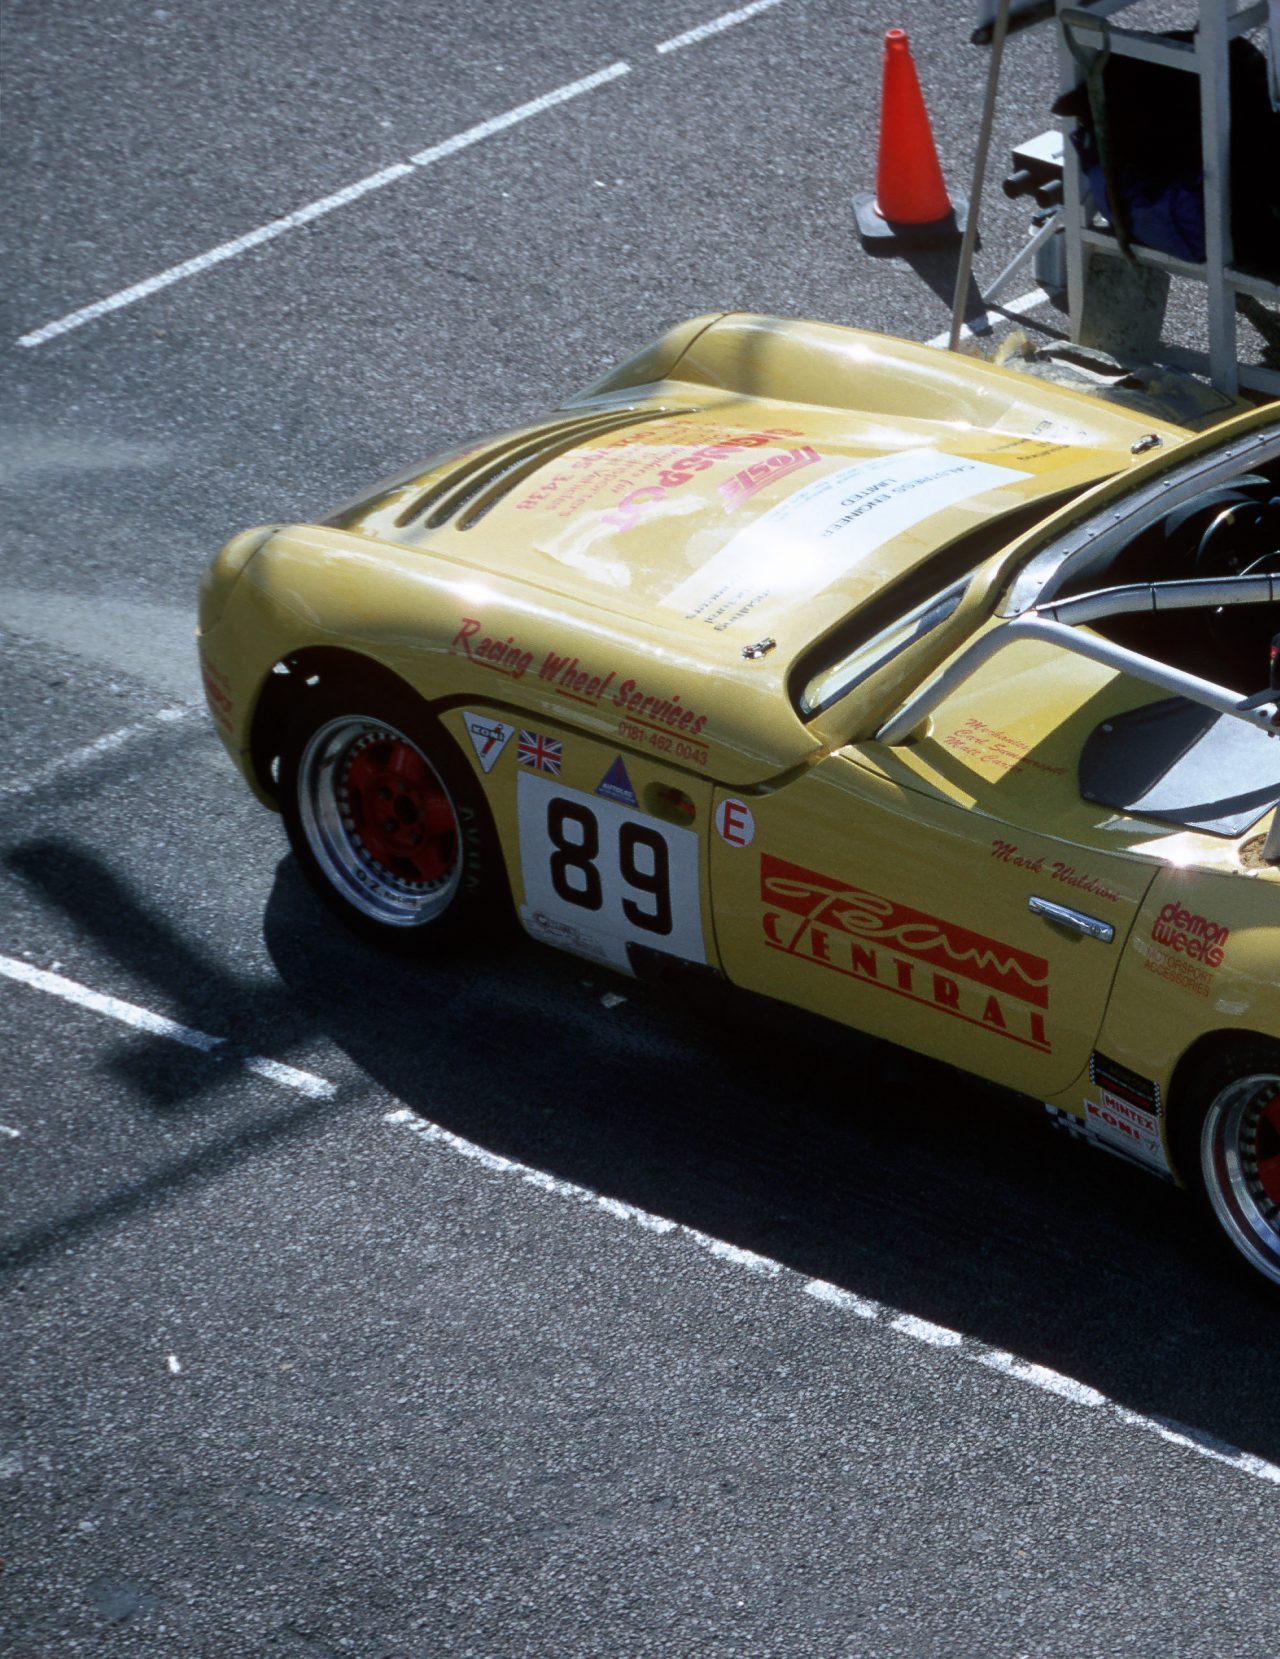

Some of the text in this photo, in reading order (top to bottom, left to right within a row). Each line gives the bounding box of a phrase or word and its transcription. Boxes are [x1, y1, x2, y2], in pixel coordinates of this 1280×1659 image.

[840, 478, 898, 507] LIMITED
[449, 617, 708, 735] Racing Wheel Services
[676, 742, 708, 766] 0043
[723, 800, 748, 846] E
[547, 797, 673, 936] 89
[991, 840, 1045, 873] Mark
[765, 877, 1049, 987] Team
[1160, 901, 1230, 947] demon
[762, 911, 1052, 1047] CENTRAL
[1143, 960, 1211, 997] ACCESSORIES
[1147, 947, 1214, 984] MOTORSPORT
[1087, 1102, 1141, 1140] KONI
[1104, 1095, 1154, 1131] MINTEX
